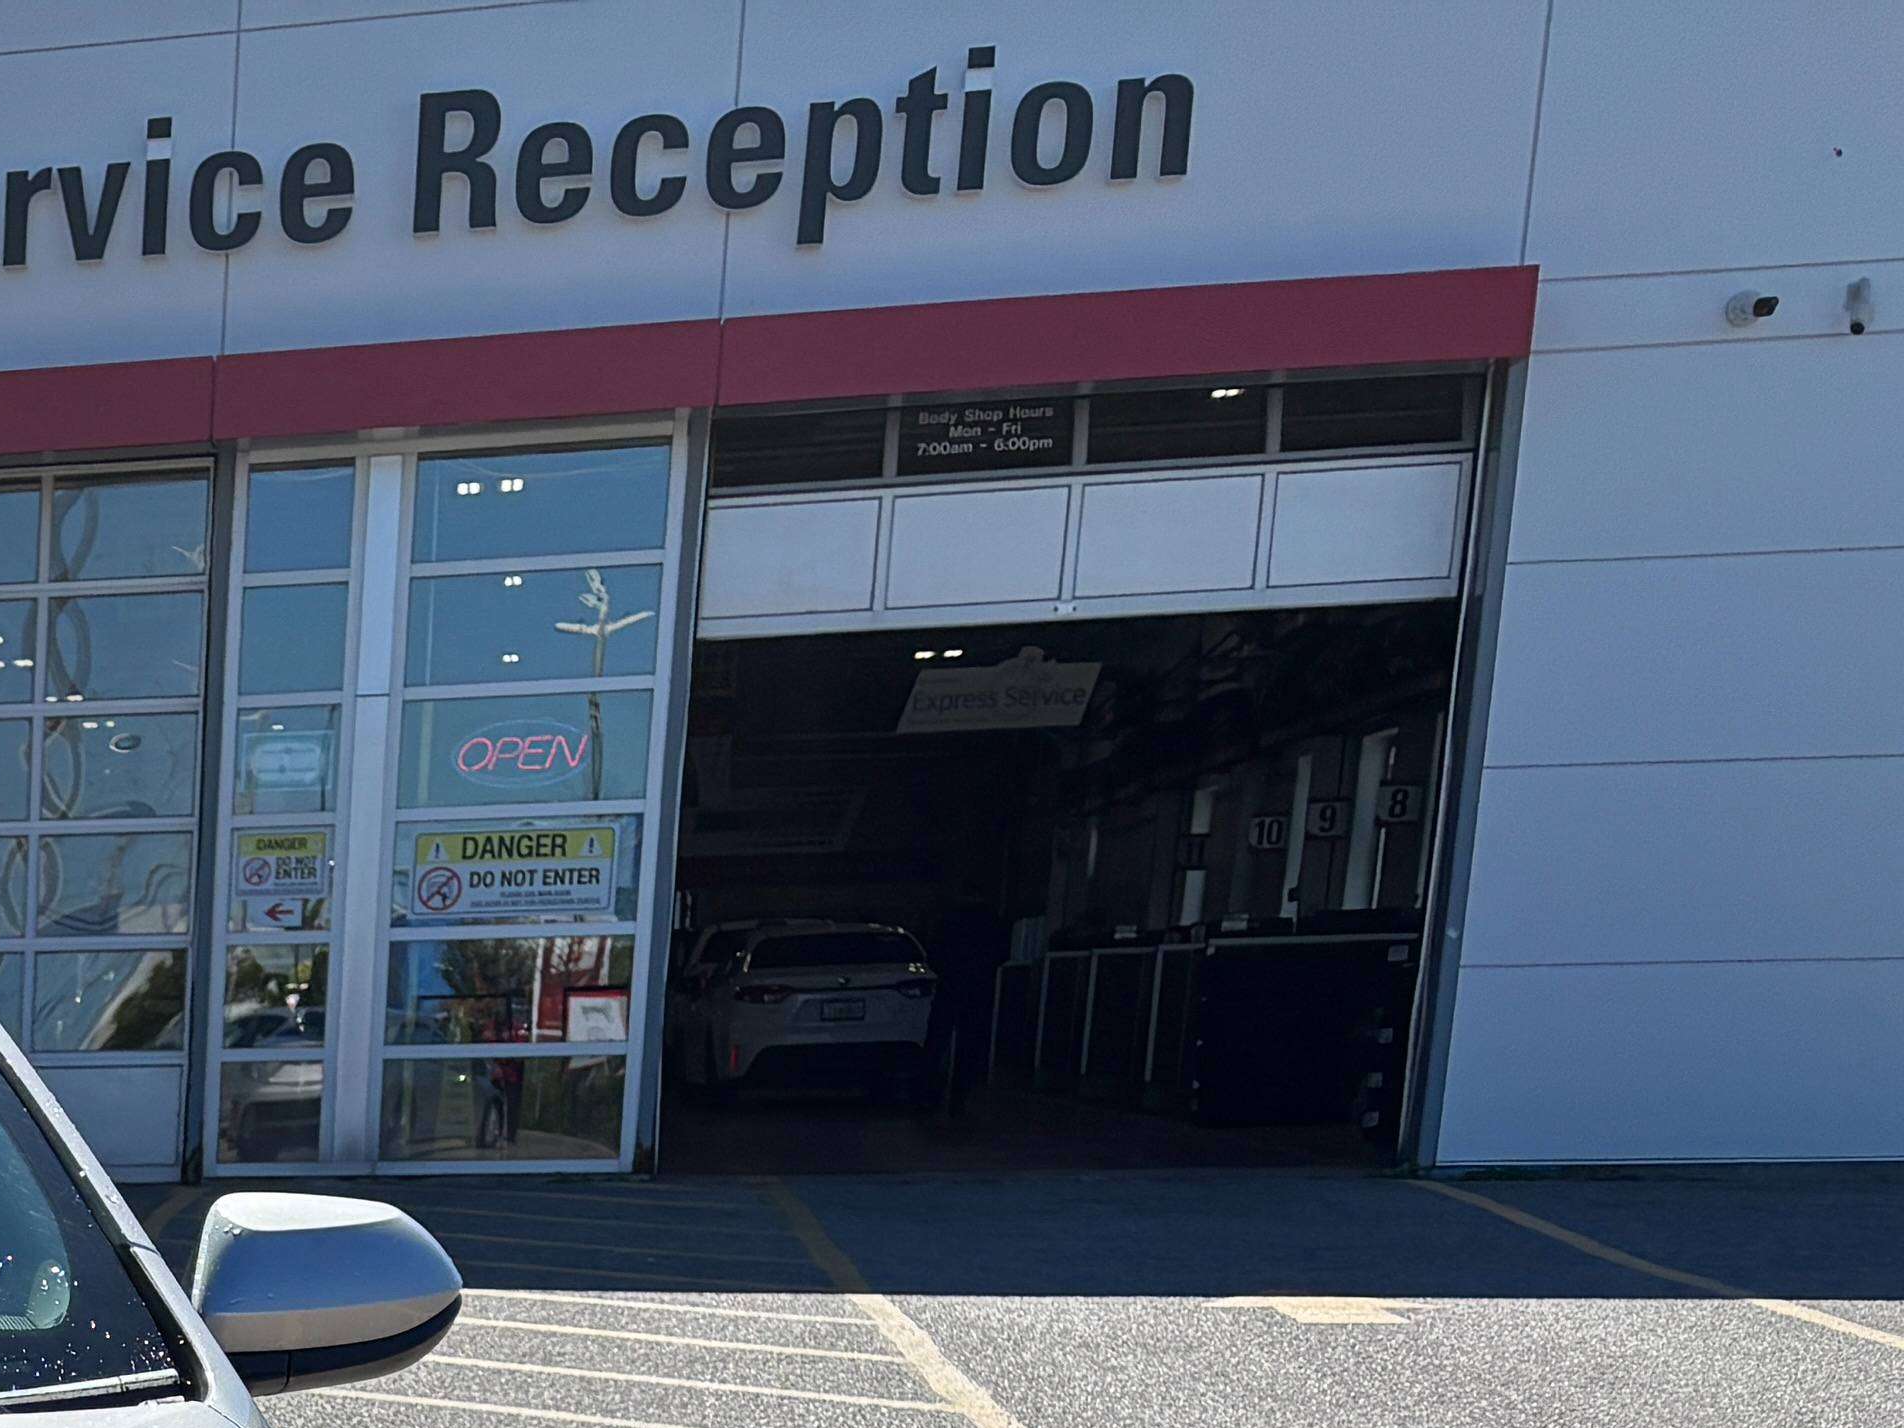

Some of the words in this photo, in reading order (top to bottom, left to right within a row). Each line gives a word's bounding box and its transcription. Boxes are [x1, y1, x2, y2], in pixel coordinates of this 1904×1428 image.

[412, 45, 1195, 247] Reception
[919, 411, 958, 425] Body
[964, 407, 1003, 422] Shop
[1009, 405, 1054, 419] Hours
[948, 425, 982, 438] Mon
[1002, 422, 1022, 436] Fri
[917, 441, 973, 456] 7:00am
[912, 690, 998, 713] Express
[1004, 686, 1086, 708] Service
[457, 735, 589, 772] OPEN
[1389, 789, 1409, 818] 8
[1255, 819, 1283, 845] 10
[1319, 804, 1337, 833] 9
[461, 833, 568, 860] DANGER
[469, 870, 495, 889] DO
[500, 869, 538, 887] NOT
[542, 867, 601, 885] ENTER
